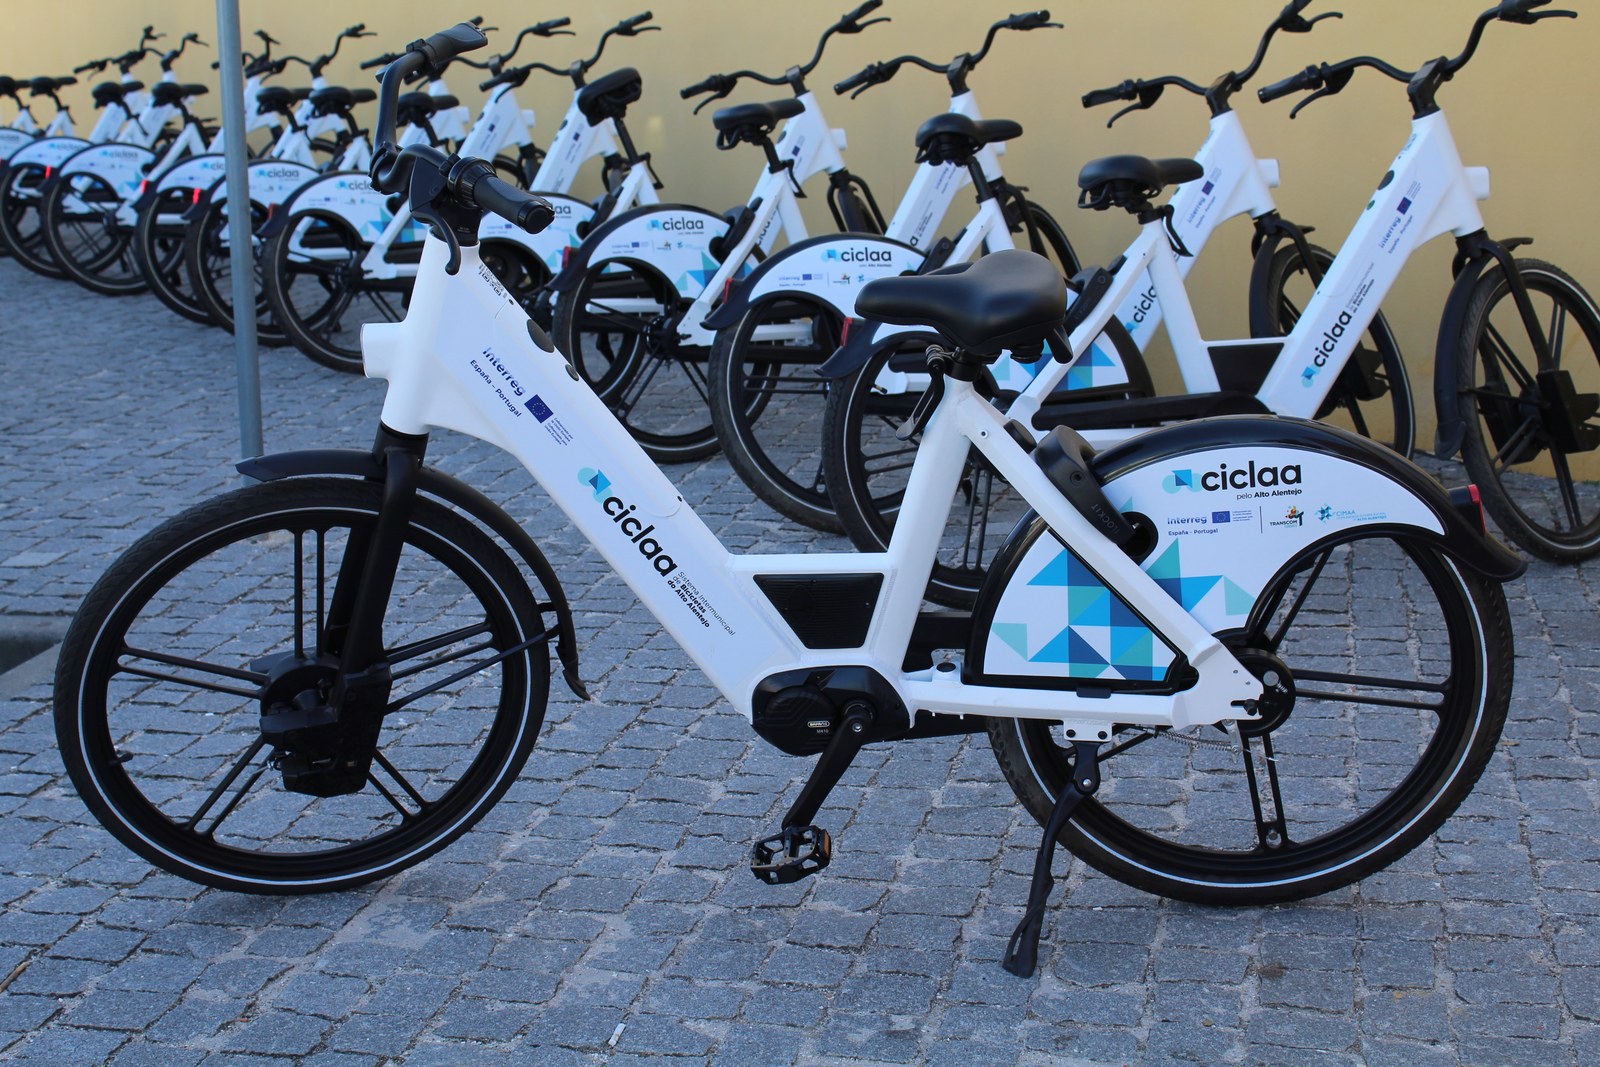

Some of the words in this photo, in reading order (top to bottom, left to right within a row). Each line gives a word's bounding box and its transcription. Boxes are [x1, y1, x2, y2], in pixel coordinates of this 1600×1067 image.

[662, 216, 704, 231] ciclaa
[841, 247, 892, 262] ciclaa
[1314, 310, 1352, 368] ciclaa
[470, 360, 492, 384] España
[496, 388, 522, 417] Portugal
[1201, 460, 1302, 492] ciclaa
[1236, 492, 1252, 500] pelo
[1254, 490, 1270, 498] Alto
[1272, 488, 1302, 498] Alentejo
[603, 496, 678, 577] ciclaa
[668, 579, 676, 589] do
[675, 588, 688, 603] Alto
[687, 602, 710, 628] Alentejo
[672, 576, 682, 585] de
[680, 584, 707, 614] Bicicletas
[678, 572, 700, 597] Sistema
[699, 594, 736, 636] intermunicipal
